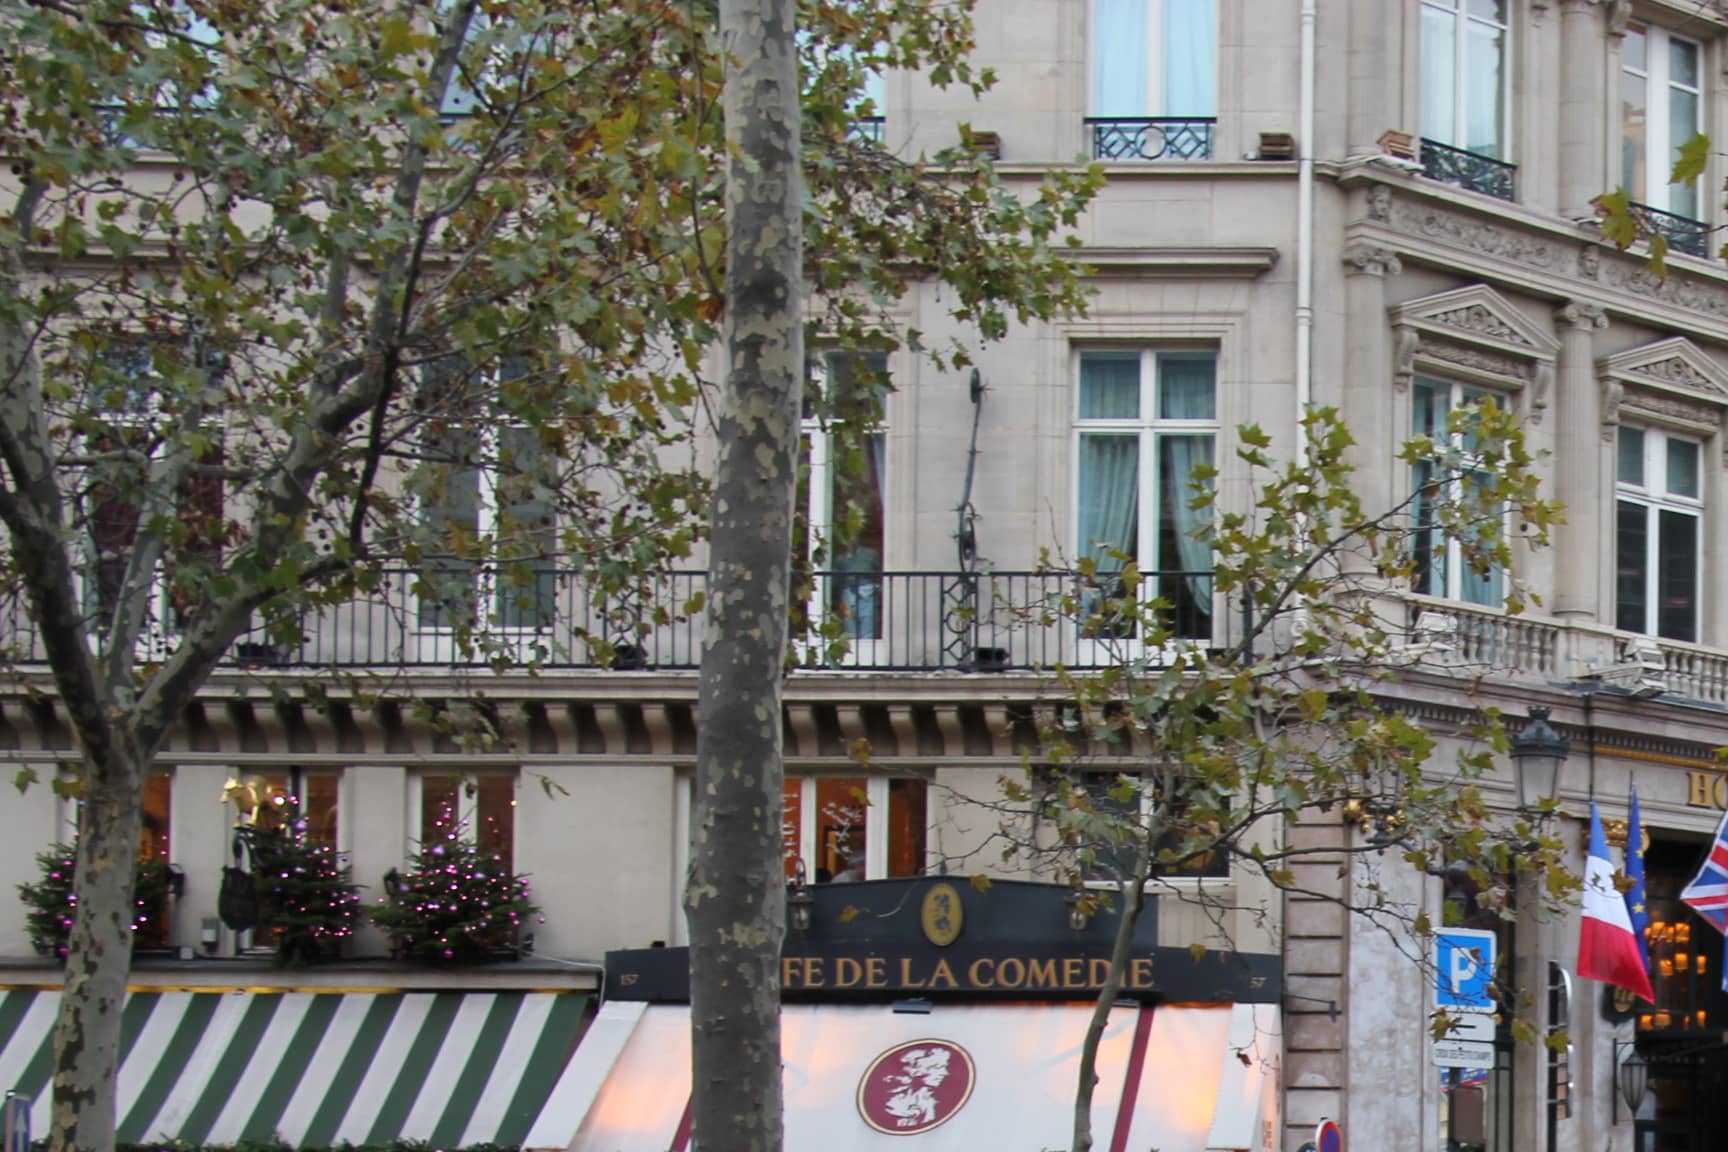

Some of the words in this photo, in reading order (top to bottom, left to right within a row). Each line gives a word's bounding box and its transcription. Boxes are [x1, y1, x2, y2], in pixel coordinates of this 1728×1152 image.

[782, 957, 825, 988] FE
[834, 957, 888, 988] DE
[901, 957, 960, 988] LA
[1450, 947, 1477, 995] P
